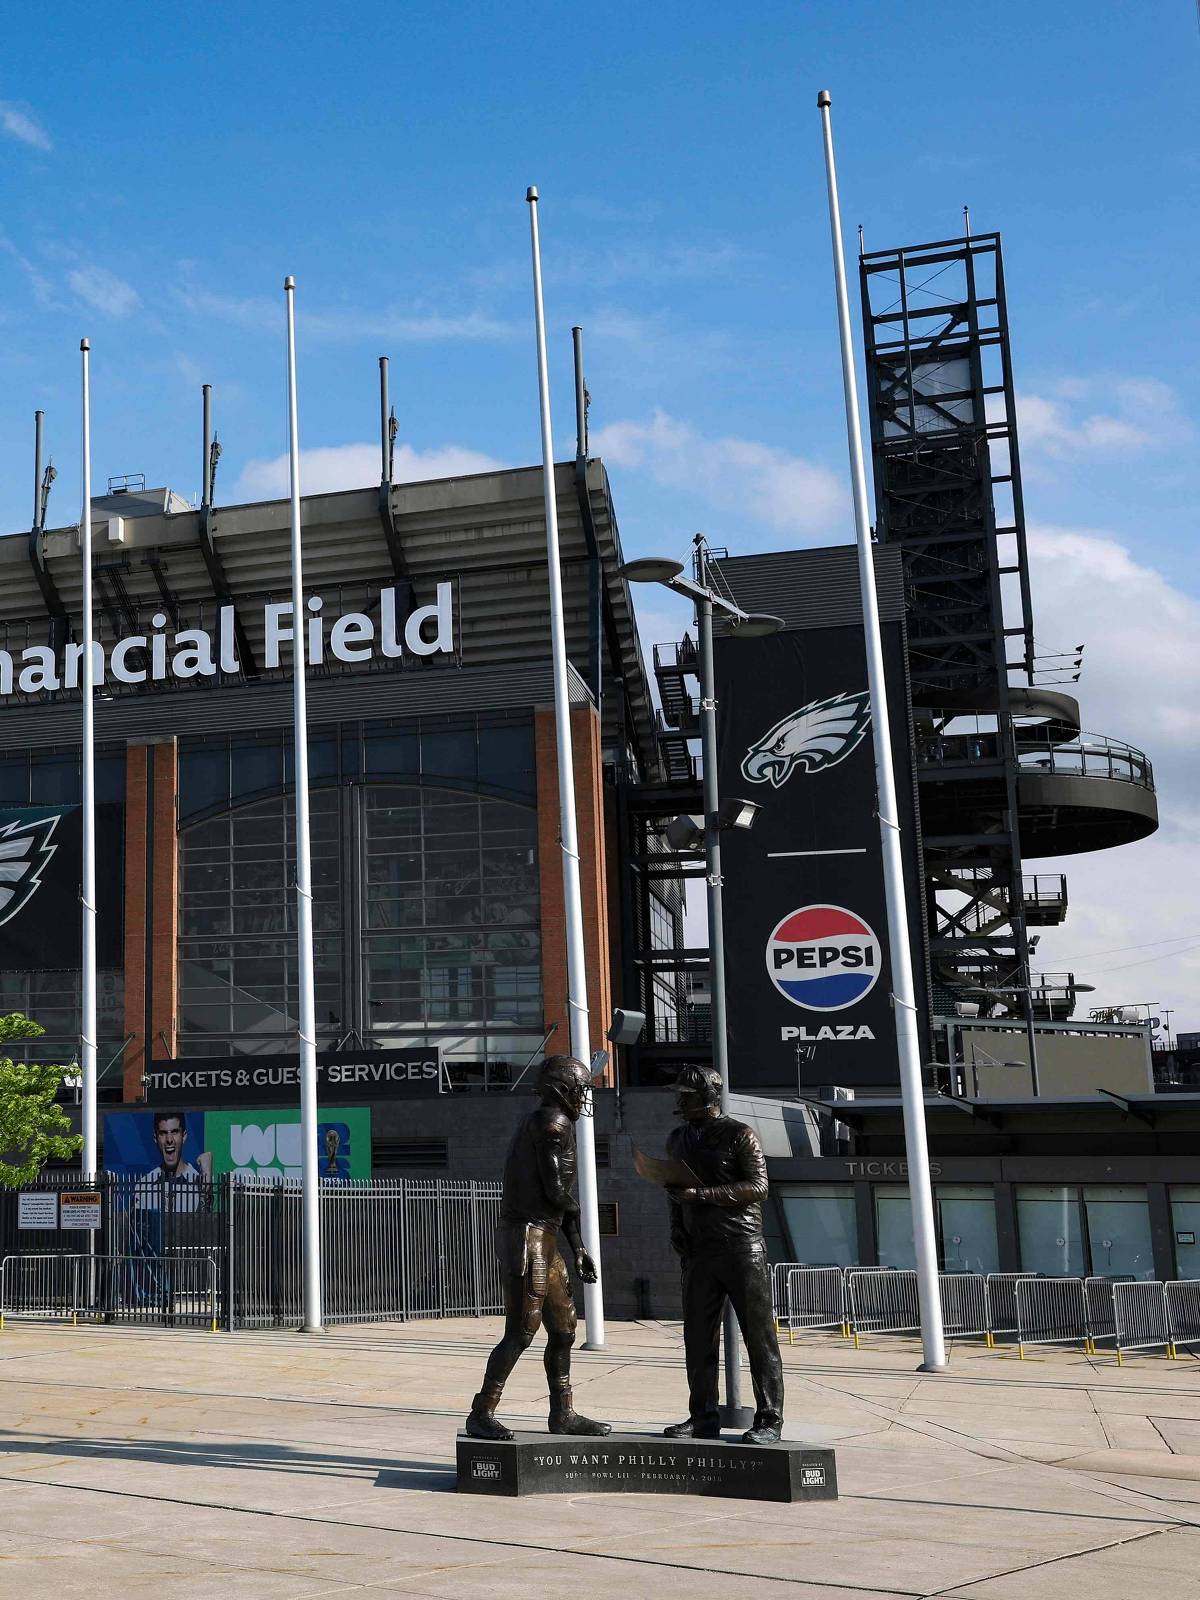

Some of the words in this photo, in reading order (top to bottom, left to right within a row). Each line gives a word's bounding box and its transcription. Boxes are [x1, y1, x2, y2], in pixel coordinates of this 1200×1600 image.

[264, 582, 454, 668] Field
[773, 945, 874, 969] PEPSI
[781, 1025, 876, 1041] PLAZA
[150, 1069, 232, 1089] TICKETS
[235, 1069, 249, 1086] &
[327, 1061, 438, 1083] SERVICES
[844, 1162, 942, 1176] TICKES
[476, 1462, 496, 1470] BUD
[569, 1455, 608, 1465] WANT
[618, 1455, 677, 1466] PHILLY
[473, 1469, 500, 1478] LIGHT
[805, 1470, 821, 1478] BUD
[802, 1477, 824, 1485] LIGHT
